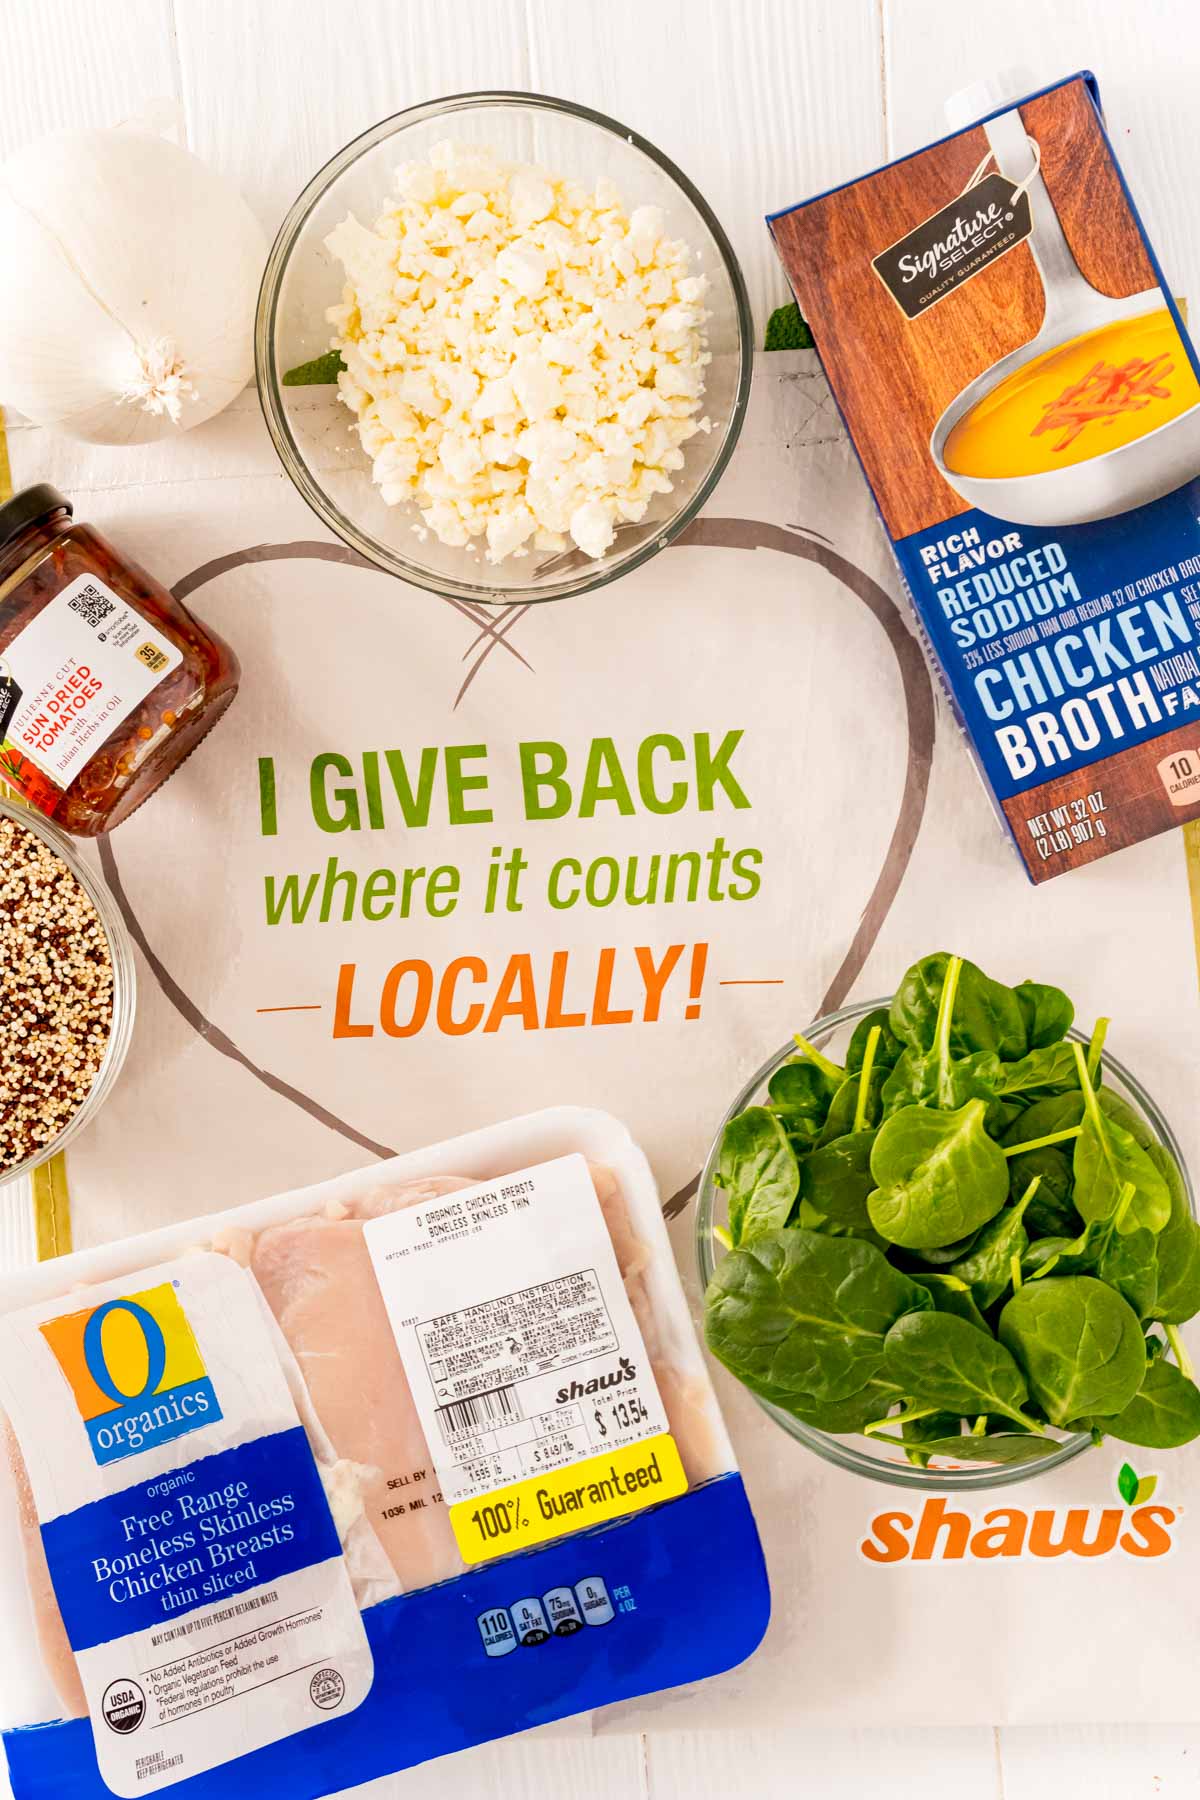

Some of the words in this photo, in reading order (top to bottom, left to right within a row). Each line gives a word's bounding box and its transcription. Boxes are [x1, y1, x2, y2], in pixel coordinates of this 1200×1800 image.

[899, 203, 1002, 283] Signature
[920, 275, 955, 304] QUALITY
[958, 233, 1015, 277] GUARANTEED
[920, 527, 981, 565] RICH
[928, 532, 1023, 585] FLAVOR
[937, 543, 1067, 619] REDUCED
[1181, 584, 1199, 604] SEE
[951, 573, 1082, 648] SODIUM
[963, 651, 984, 670] 33%
[982, 641, 1005, 662] LESS
[1003, 626, 1040, 653] SODIUM
[1037, 617, 1062, 638] THAN
[1059, 611, 1079, 630] OUR
[1078, 594, 1115, 622] REGULAR
[1112, 589, 1125, 607] 32
[1124, 584, 1139, 601] OZ
[1136, 566, 1179, 597] CHICKEN
[1178, 554, 1200, 579] BRO
[140, 646, 155, 660] 35
[973, 591, 1193, 722] CHICKEN
[1150, 650, 1200, 692] NATURAL
[13, 682, 55, 732] JULIENNE
[56, 658, 77, 681] CUT
[22, 713, 49, 744] SUN
[47, 666, 91, 714] DRIED
[36, 678, 103, 753] TOMATOES
[56, 746, 79, 771] Italian
[76, 721, 100, 747] Herbs
[98, 711, 109, 722] in
[107, 695, 122, 711] Oil
[70, 717, 88, 737] with
[994, 671, 1163, 781] BROTH
[258, 758, 277, 835] I
[310, 744, 493, 834] GIVE
[519, 730, 752, 820] BACK
[1170, 757, 1192, 780] 10
[1170, 776, 1200, 794] CALORIE
[1026, 814, 1051, 838] NET
[1049, 806, 1071, 829] WT
[1070, 799, 1089, 821] 32
[1088, 791, 1108, 814] OZ
[1036, 832, 1052, 860] (2
[1050, 829, 1073, 854] LB)
[1071, 821, 1094, 845] 907
[1096, 820, 1107, 837] g
[264, 857, 460, 925] where
[485, 846, 528, 913] it
[548, 838, 763, 909] counts
[333, 943, 708, 1038] LOCALLY!
[426, 1204, 463, 1224] ORGANICS
[466, 1192, 498, 1211] CHICKEN
[501, 1181, 535, 1200] BREASTS
[429, 1217, 468, 1238] BONELESS
[472, 1204, 508, 1224] SKINLESS
[512, 1198, 530, 1211] THIN
[433, 1315, 459, 1329] SAFE
[464, 1297, 514, 1319] HANDLING
[592, 1394, 613, 1407] Total
[617, 1388, 638, 1397] Price
[613, 1398, 648, 1430] 13.54
[97, 1391, 209, 1448] organics
[552, 1434, 568, 1443] Price
[451, 1441, 472, 1452] Packed
[147, 1472, 195, 1498] organic
[386, 1478, 411, 1490] SELL
[413, 1470, 427, 1481] BY
[472, 1498, 529, 1541] 100%
[538, 1453, 662, 1520] Guaranteed
[120, 1510, 174, 1542] Free
[178, 1481, 250, 1520] Range
[382, 1507, 406, 1520] 1036
[409, 1497, 428, 1512] MIL
[432, 1493, 444, 1505] 12
[91, 1531, 196, 1582] Boneless
[199, 1494, 295, 1542] Skinless
[110, 1555, 204, 1603] Chicken
[207, 1524, 294, 1568] Breasts
[161, 1583, 199, 1611] thin
[203, 1561, 257, 1596] sliced
[584, 1597, 608, 1611] SUGARS
[613, 1586, 631, 1600] PER
[624, 1599, 637, 1612] OZ
[152, 1635, 163, 1647] MAY
[164, 1626, 186, 1642] CONTAIN
[186, 1625, 194, 1635] UP
[193, 1622, 201, 1631] TO
[201, 1616, 214, 1629] FIVE
[213, 1608, 235, 1625] PERCENT
[235, 1599, 260, 1618] RETAINED
[261, 1591, 279, 1608] WATER
[482, 1613, 507, 1636] 110
[519, 1620, 531, 1631] SAT
[531, 1617, 543, 1627] FAT
[552, 1607, 575, 1621] SODIUM
[151, 1672, 162, 1683] No
[163, 1659, 186, 1678] Added
[187, 1648, 223, 1669] Antibiotics
[225, 1646, 232, 1656] or
[234, 1633, 258, 1651] Added
[258, 1626, 286, 1642] Growth
[485, 1630, 513, 1646] CALORIES
[154, 1678, 182, 1697] Organic
[182, 1664, 220, 1686] Vegetarian
[220, 1655, 238, 1670] Feed
[187, 1675, 225, 1697] regulations
[226, 1664, 252, 1682] prohibit
[252, 1658, 265, 1670] the
[266, 1654, 279, 1665] use
[111, 1690, 135, 1708] USDA
[111, 1704, 141, 1722] ORGANIC
[160, 1710, 167, 1720] of
[168, 1698, 203, 1718] hormones
[204, 1695, 211, 1705] in
[212, 1685, 235, 1702] poultry
[137, 1768, 148, 1780] KEEP
[149, 1754, 184, 1775] REFRIGERATED
